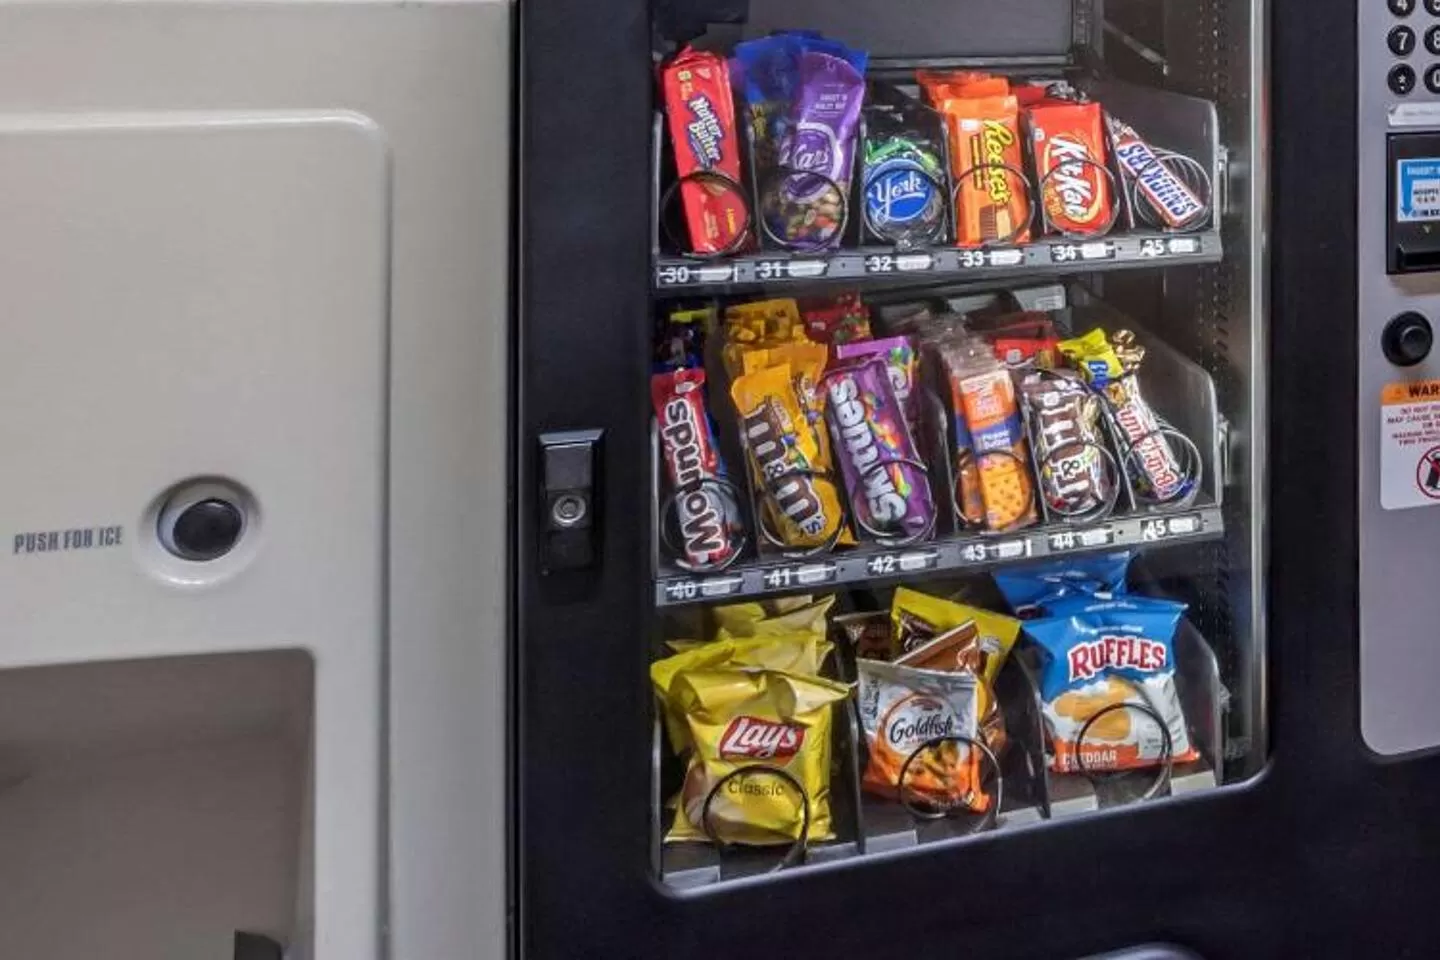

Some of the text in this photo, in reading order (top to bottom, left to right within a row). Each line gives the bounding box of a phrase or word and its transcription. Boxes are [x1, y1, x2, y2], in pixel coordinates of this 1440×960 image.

[1397, 31, 1409, 51] 7
[1117, 142, 1202, 219] SNICKERS
[869, 171, 923, 217] York
[869, 256, 891, 271] 32
[963, 252, 985, 267] 33
[665, 268, 689, 283] 30
[760, 262, 782, 277] 31
[663, 397, 725, 557] Mounds
[13, 524, 124, 555] PUSH FOR ICE
[963, 544, 986, 560] 43
[872, 556, 895, 573] 42
[769, 569, 792, 585] 41
[672, 583, 696, 599] 40
[1068, 636, 1166, 682] RUFFLES
[890, 713, 954, 744] Goldfish
[728, 778, 785, 797] Classic
